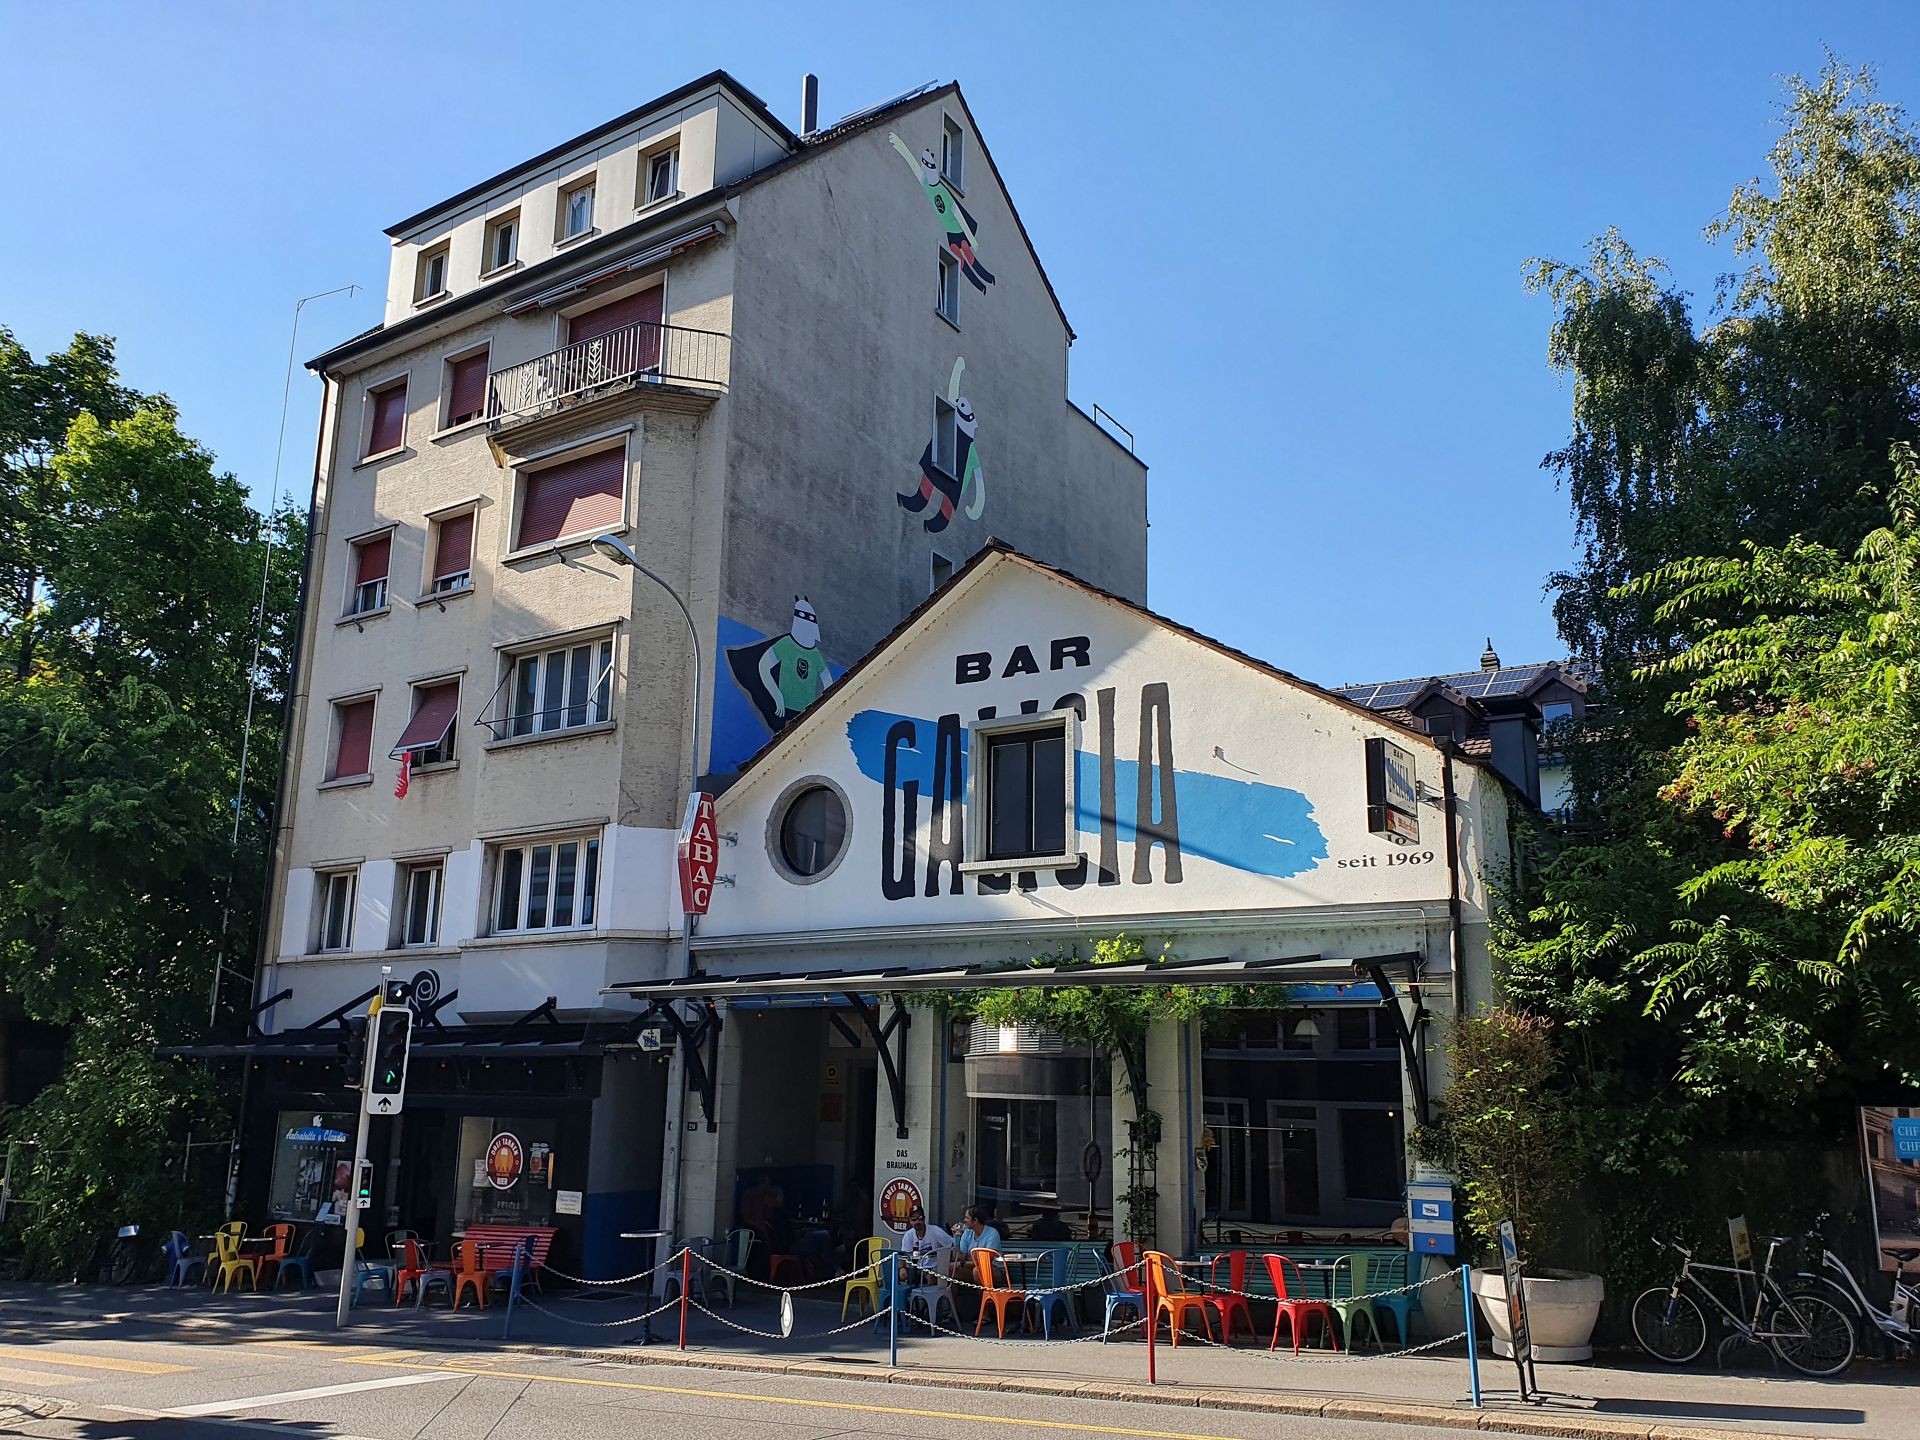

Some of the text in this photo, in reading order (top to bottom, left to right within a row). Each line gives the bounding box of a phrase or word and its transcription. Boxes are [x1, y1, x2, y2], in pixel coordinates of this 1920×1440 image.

[955, 635, 1091, 684] BAR
[1393, 749, 1404, 760] BAR
[882, 682, 1183, 901] GAIA
[691, 800, 714, 907] TABAC
[1337, 851, 1434, 869] seit 1969
[1897, 1126, 1919, 1137] CHF
[491, 1140, 501, 1156] DREI
[502, 1138, 519, 1156] TANNEN
[896, 1149, 908, 1158] DAS
[886, 1161, 918, 1170] BRAUHAUS
[497, 1177, 508, 1185] BIER
[884, 1182, 919, 1201] DREI TANNEN
[893, 1222, 907, 1230] BIER
